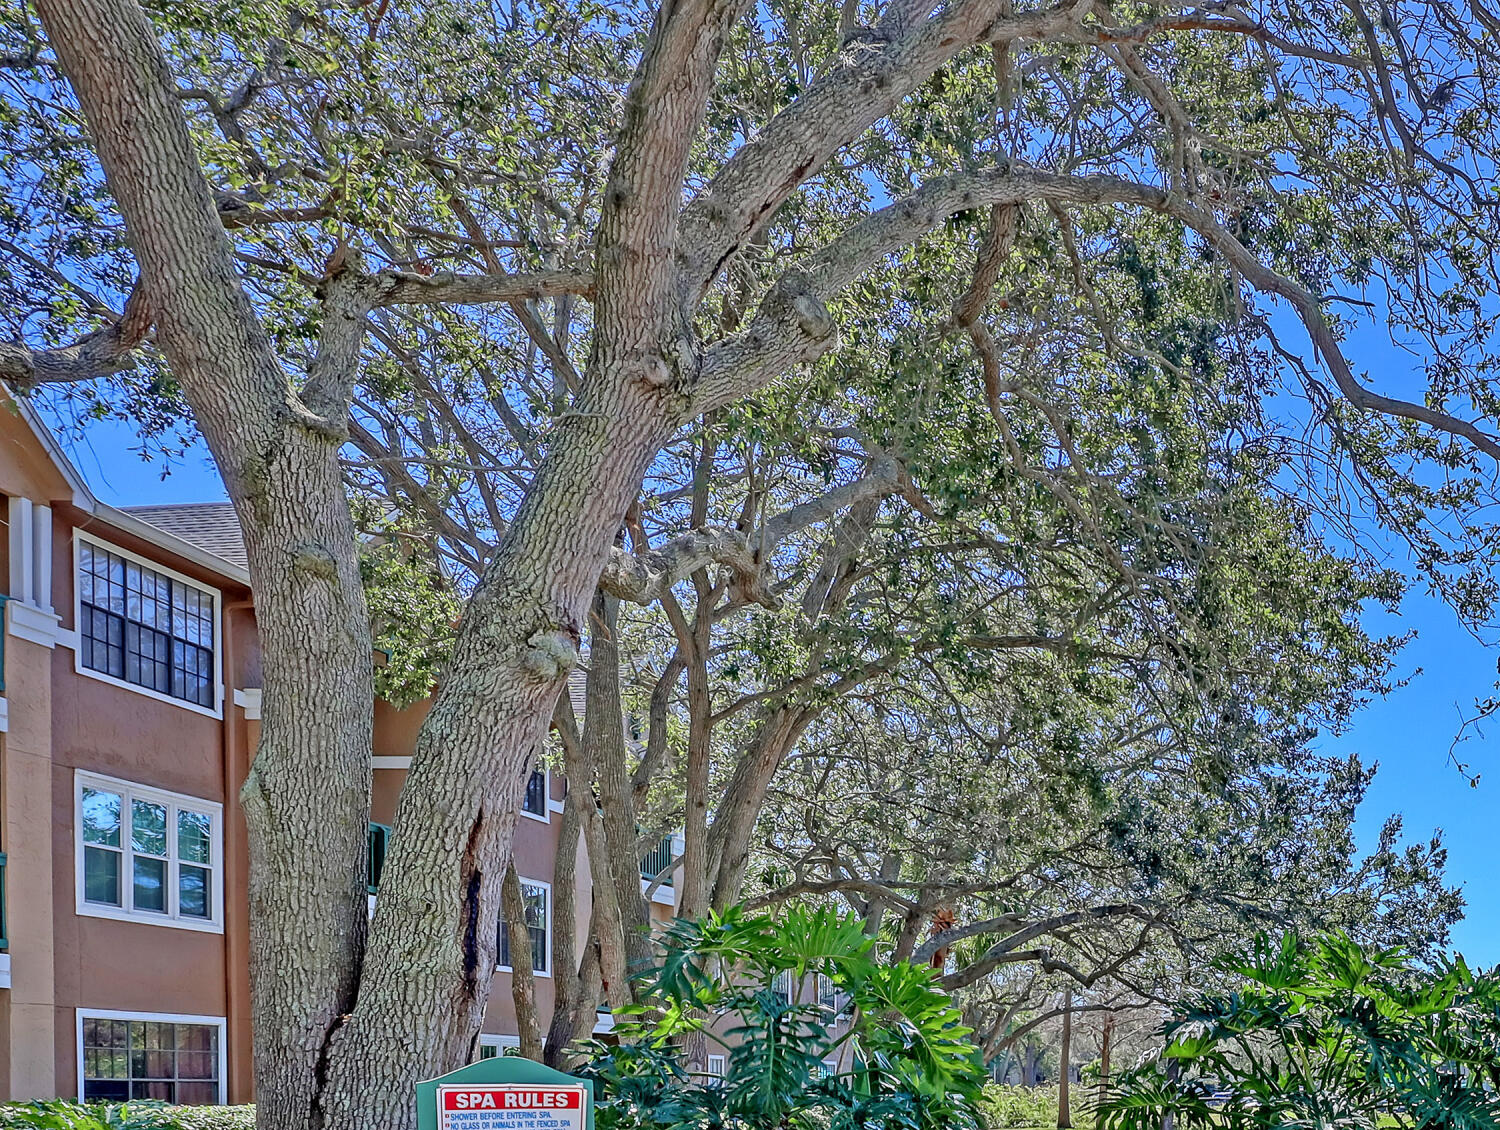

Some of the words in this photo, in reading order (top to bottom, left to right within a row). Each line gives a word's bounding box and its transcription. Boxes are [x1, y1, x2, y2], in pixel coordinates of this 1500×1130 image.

[456, 1093, 496, 1108] SPA
[505, 1093, 568, 1107] RULES
[451, 1113, 478, 1121] SHOWER
